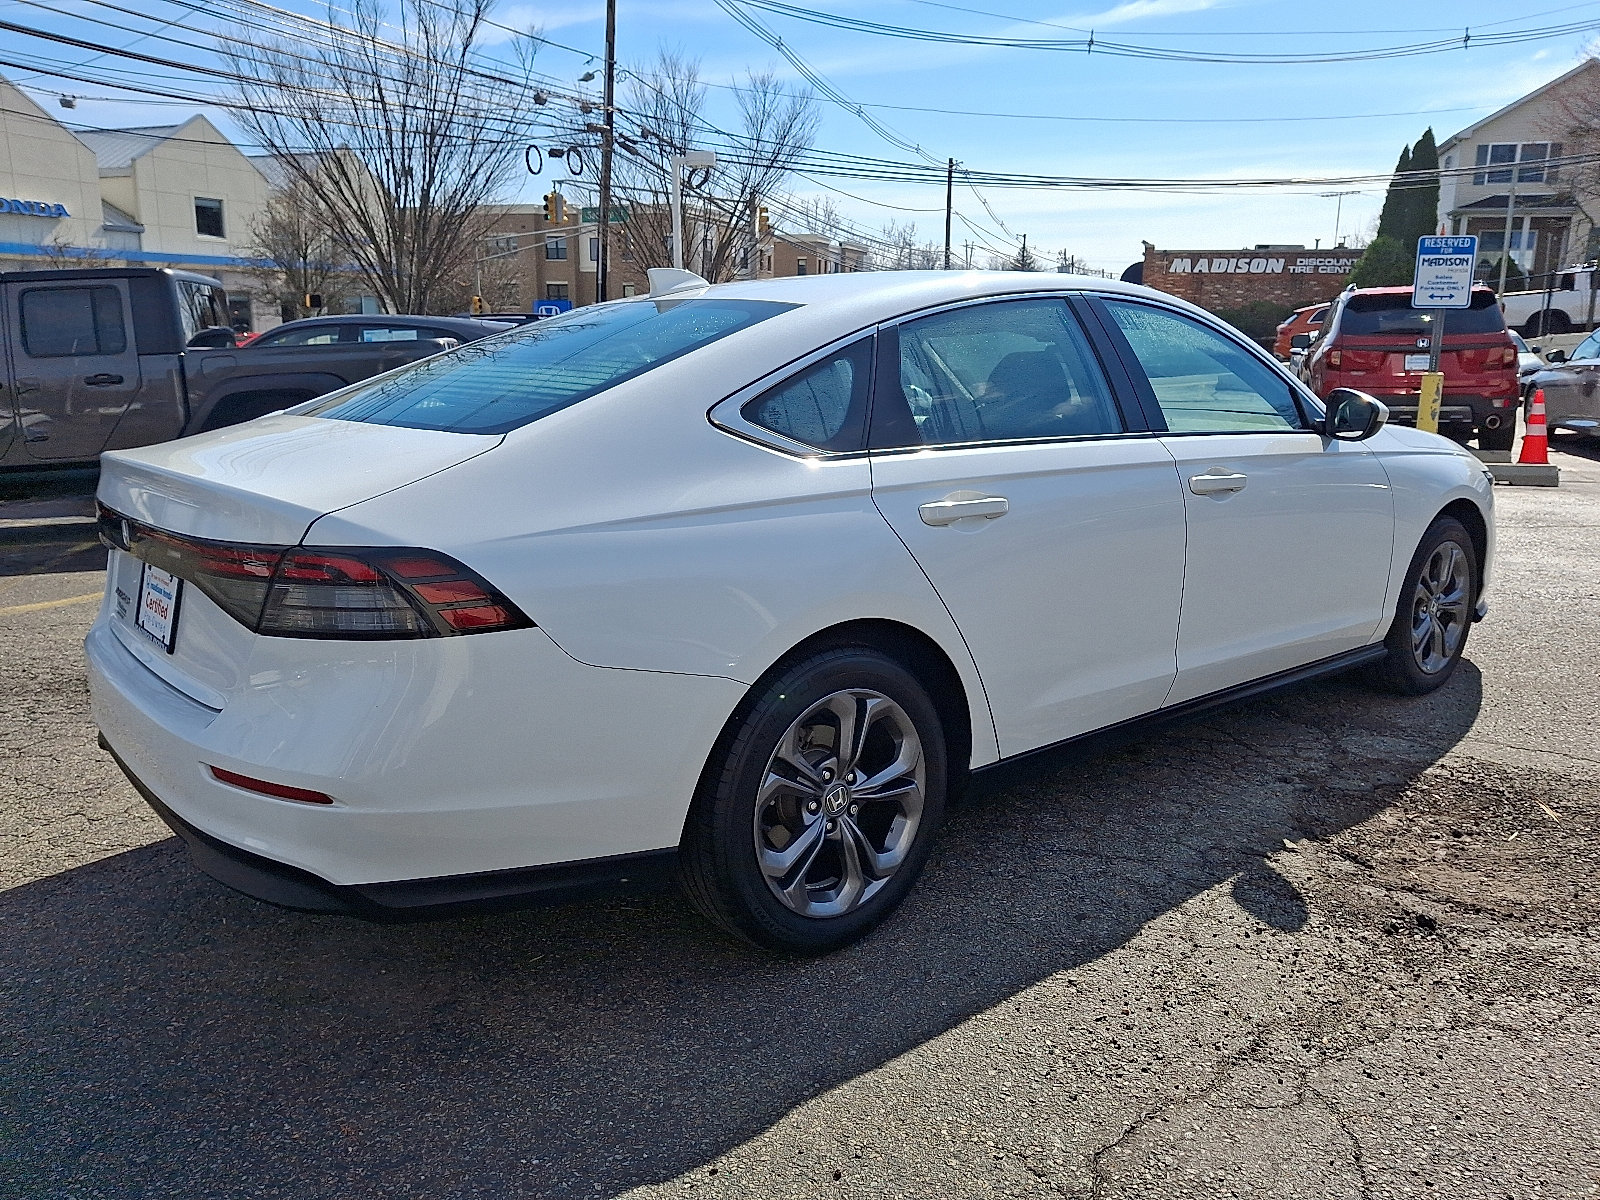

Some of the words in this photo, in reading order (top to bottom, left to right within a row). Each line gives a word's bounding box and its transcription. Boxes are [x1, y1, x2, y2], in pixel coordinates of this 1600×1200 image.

[0, 197, 71, 217] ONDA
[1424, 238, 1471, 248] RESERVED
[1168, 258, 1286, 274] MADISON
[1421, 257, 1470, 267] MADISON
[1288, 266, 1314, 274] TIRE
[1318, 266, 1352, 274] CENT
[145, 591, 169, 620] Certified
